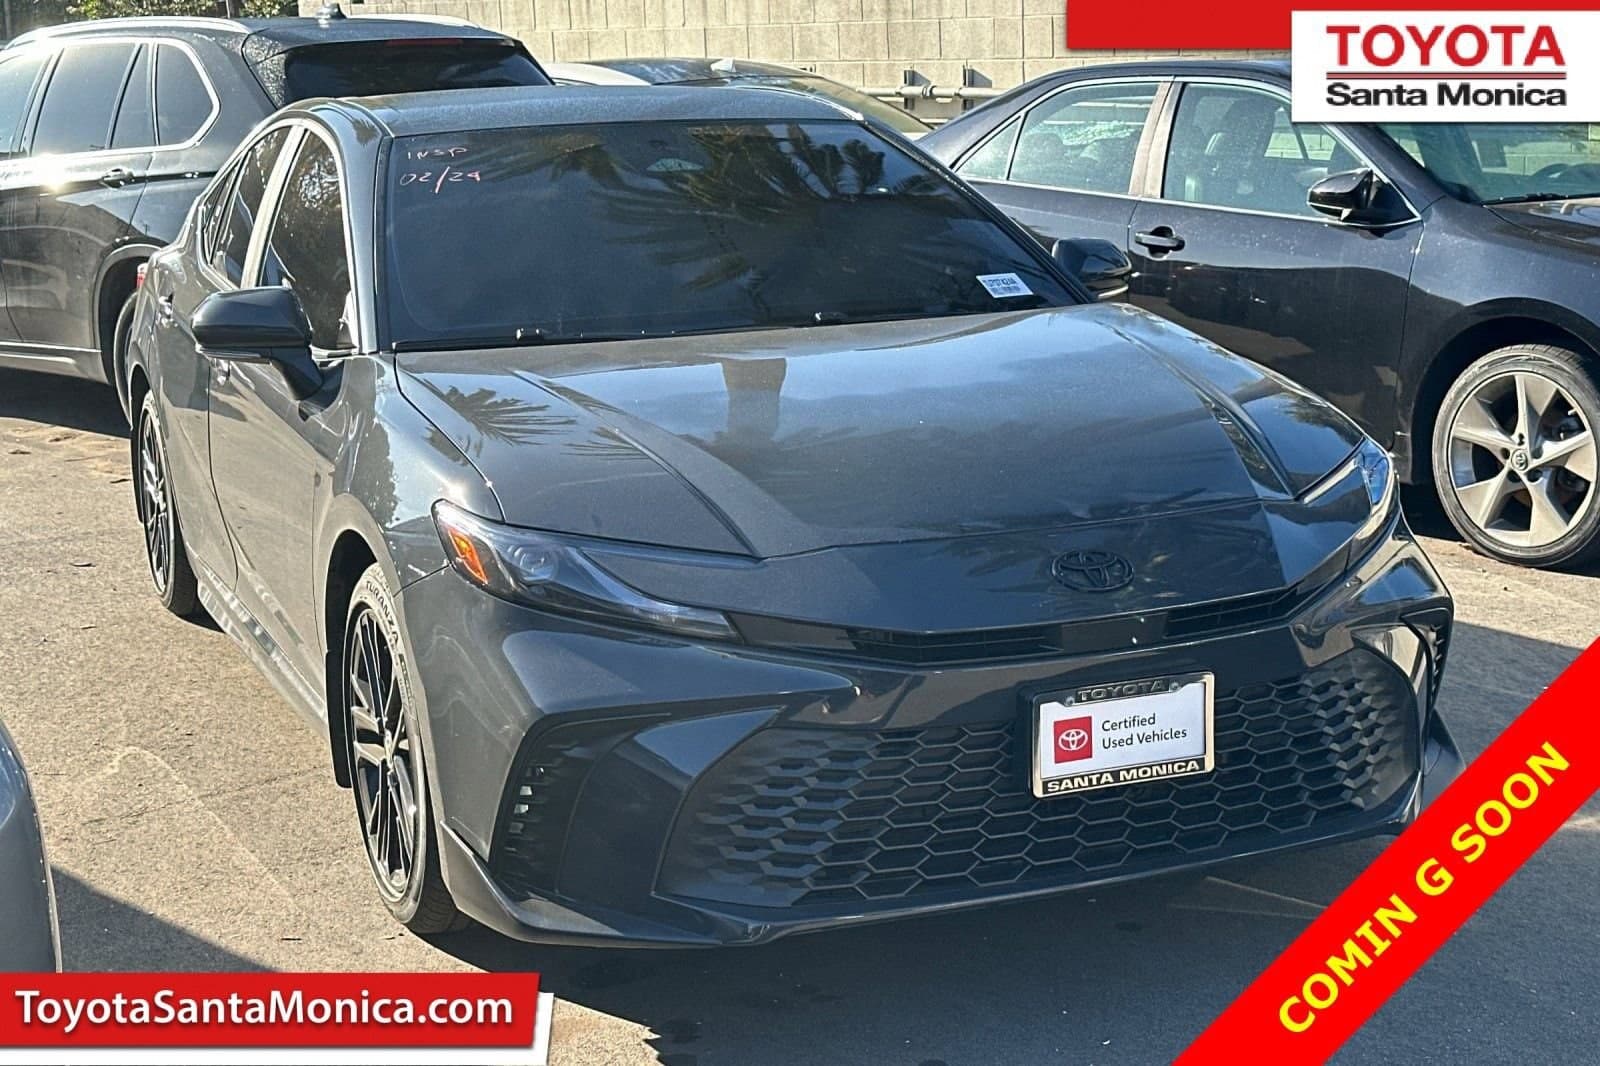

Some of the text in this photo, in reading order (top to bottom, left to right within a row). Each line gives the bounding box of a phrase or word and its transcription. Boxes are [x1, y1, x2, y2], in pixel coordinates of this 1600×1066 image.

[1077, 680, 1167, 702] TOYOTA
[1101, 712, 1156, 732] Certified
[1101, 726, 1187, 750] Used Vehicles
[1047, 759, 1200, 793] SANTA MONICA
